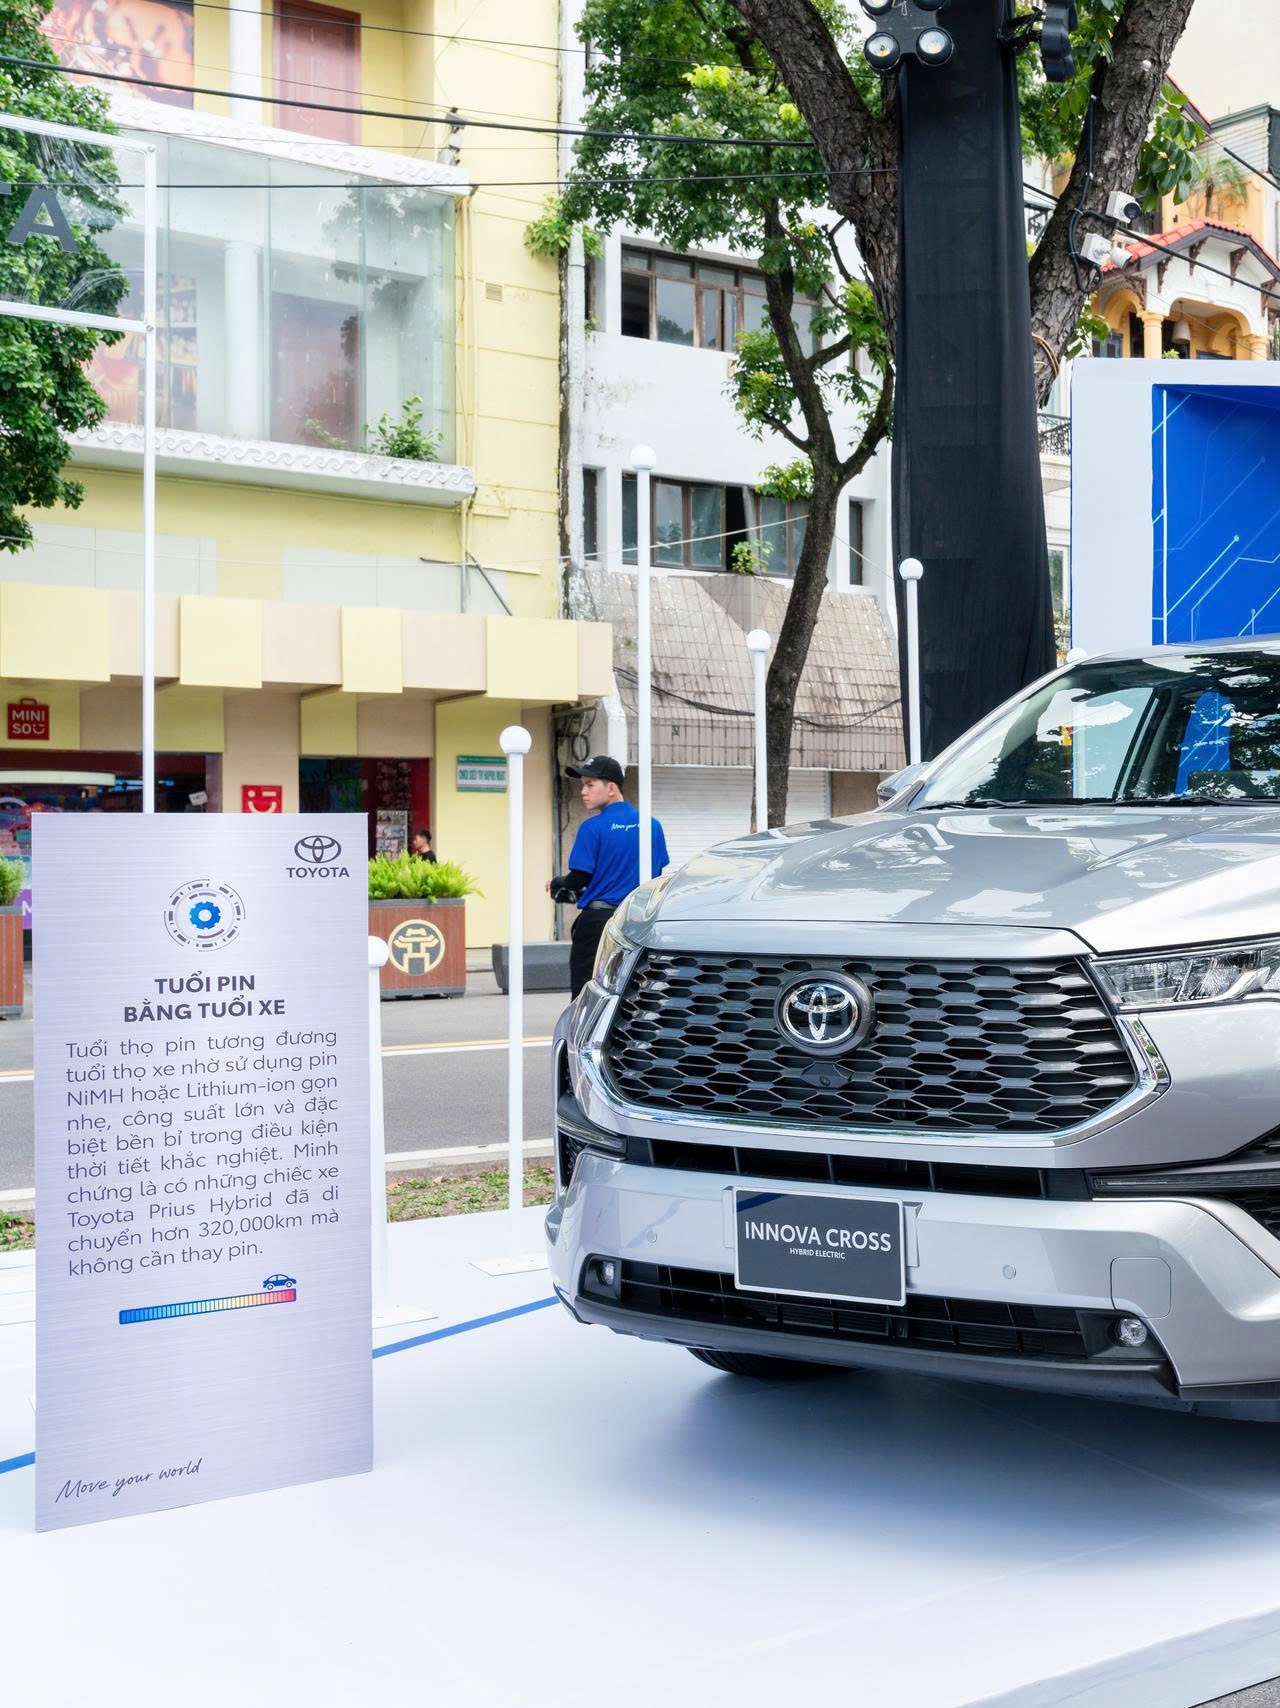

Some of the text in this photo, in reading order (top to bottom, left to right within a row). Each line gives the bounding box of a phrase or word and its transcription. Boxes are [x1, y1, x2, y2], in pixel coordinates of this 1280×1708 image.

[0, 182, 80, 253] A
[12, 709, 46, 721] MINI
[285, 867, 350, 878] TOYOTA
[155, 970, 255, 994] TUỔI PIN
[124, 995, 285, 1022] BẰNG TUỔI XE
[65, 1030, 337, 1058] Tuổi thọ pin tương đương
[66, 1052, 337, 1083] tuổi thọ xe nhờ sử dụng pin
[68, 1076, 337, 1107] NiMH hoặc Lithium-ion gọn
[68, 1096, 338, 1131] nhẹ, công suất lớn và đặc
[68, 1119, 338, 1157] biệt bền bỉ trong điều kiện
[67, 1140, 338, 1179] thời tiết khắc nghiệt. Minh
[68, 1165, 339, 1204] chứng là có những chiếc xe
[68, 1185, 339, 1229] Toyota Prius Hybrid đã di
[68, 1207, 339, 1252] chuyển hơn 320,000km mà
[745, 1221, 891, 1251] INNOVA CROSS
[69, 1240, 263, 1277] không cần thay pin.
[790, 1247, 846, 1259] HYBRID ELECTRIC
[55, 1457, 203, 1503] Move your world
